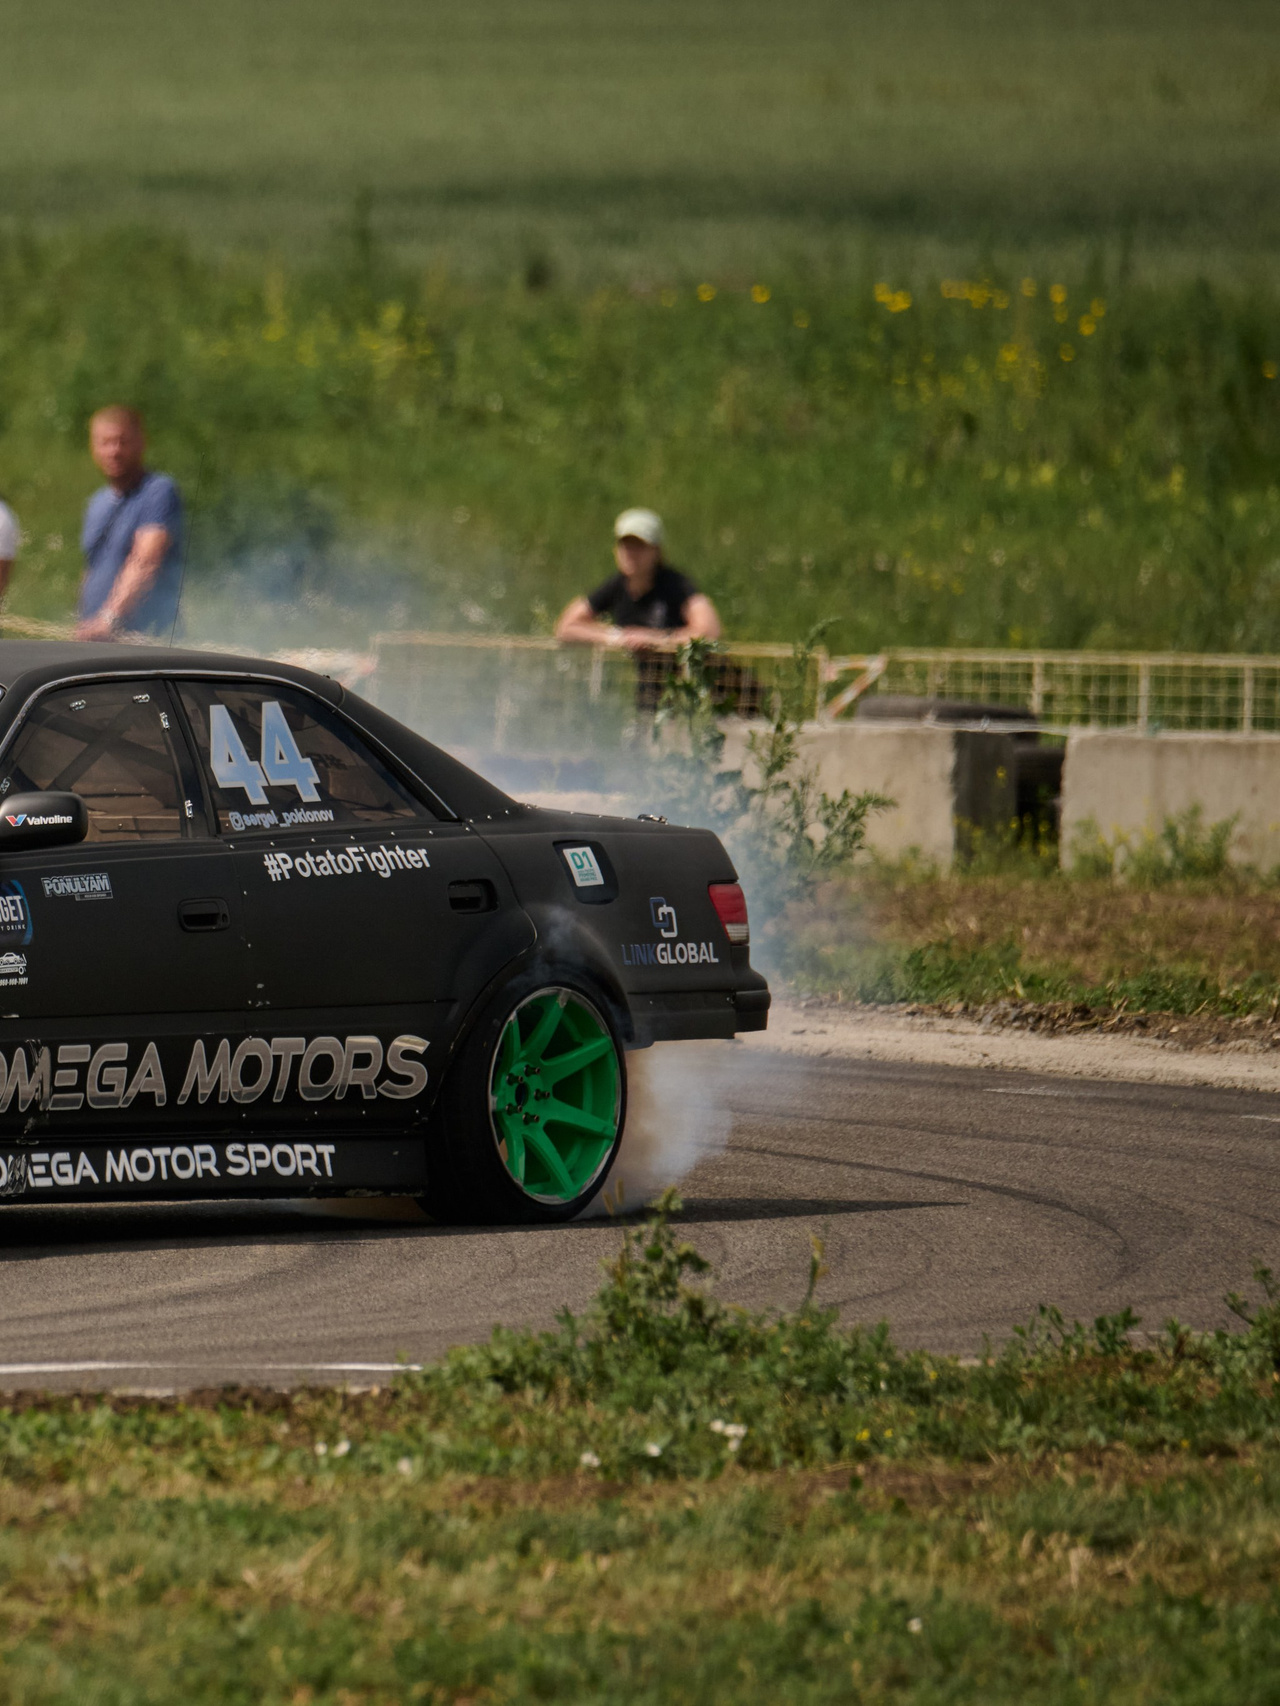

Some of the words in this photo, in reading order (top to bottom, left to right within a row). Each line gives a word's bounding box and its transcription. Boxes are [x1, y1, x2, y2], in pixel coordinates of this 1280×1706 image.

[210, 701, 322, 806] 44
[26, 814, 73, 826] Valvoline
[263, 845, 431, 882] #PotatoFighter
[7, 924, 26, 932] DRINK
[176, 1034, 431, 1106] MOTORS
[105, 1144, 221, 1185] MOTOR
[225, 1143, 336, 1179] SPORT
